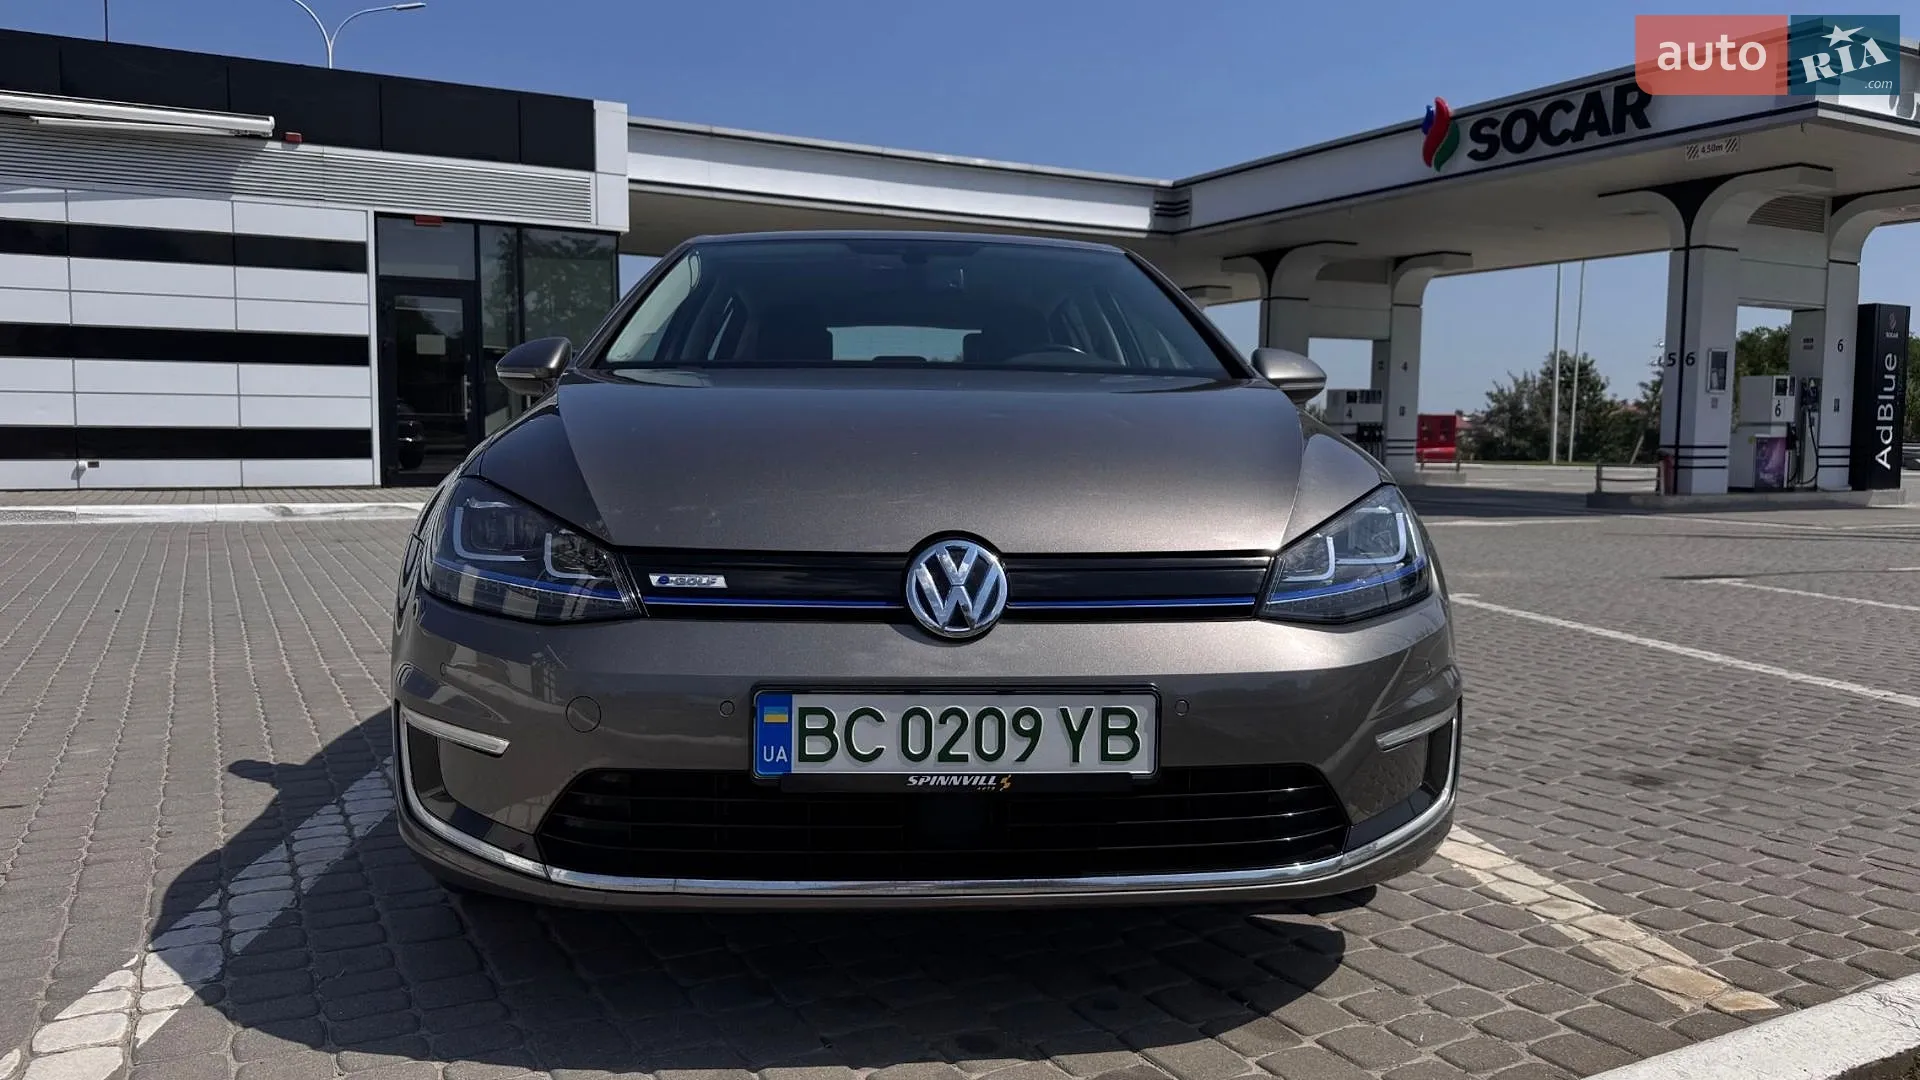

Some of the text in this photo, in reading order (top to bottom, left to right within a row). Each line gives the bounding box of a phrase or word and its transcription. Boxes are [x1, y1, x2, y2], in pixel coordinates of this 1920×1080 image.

[1467, 82, 1654, 163] SOCAR
[1837, 338, 1844, 353] 6
[1666, 352, 1677, 367] 5
[1685, 351, 1696, 367] 6
[1875, 352, 1898, 471] AdBlue
[914, 541, 1001, 630] VW
[797, 705, 1142, 764] BC 0209 YB
[763, 746, 788, 763] UA
[906, 775, 997, 786] SPINNVILL
